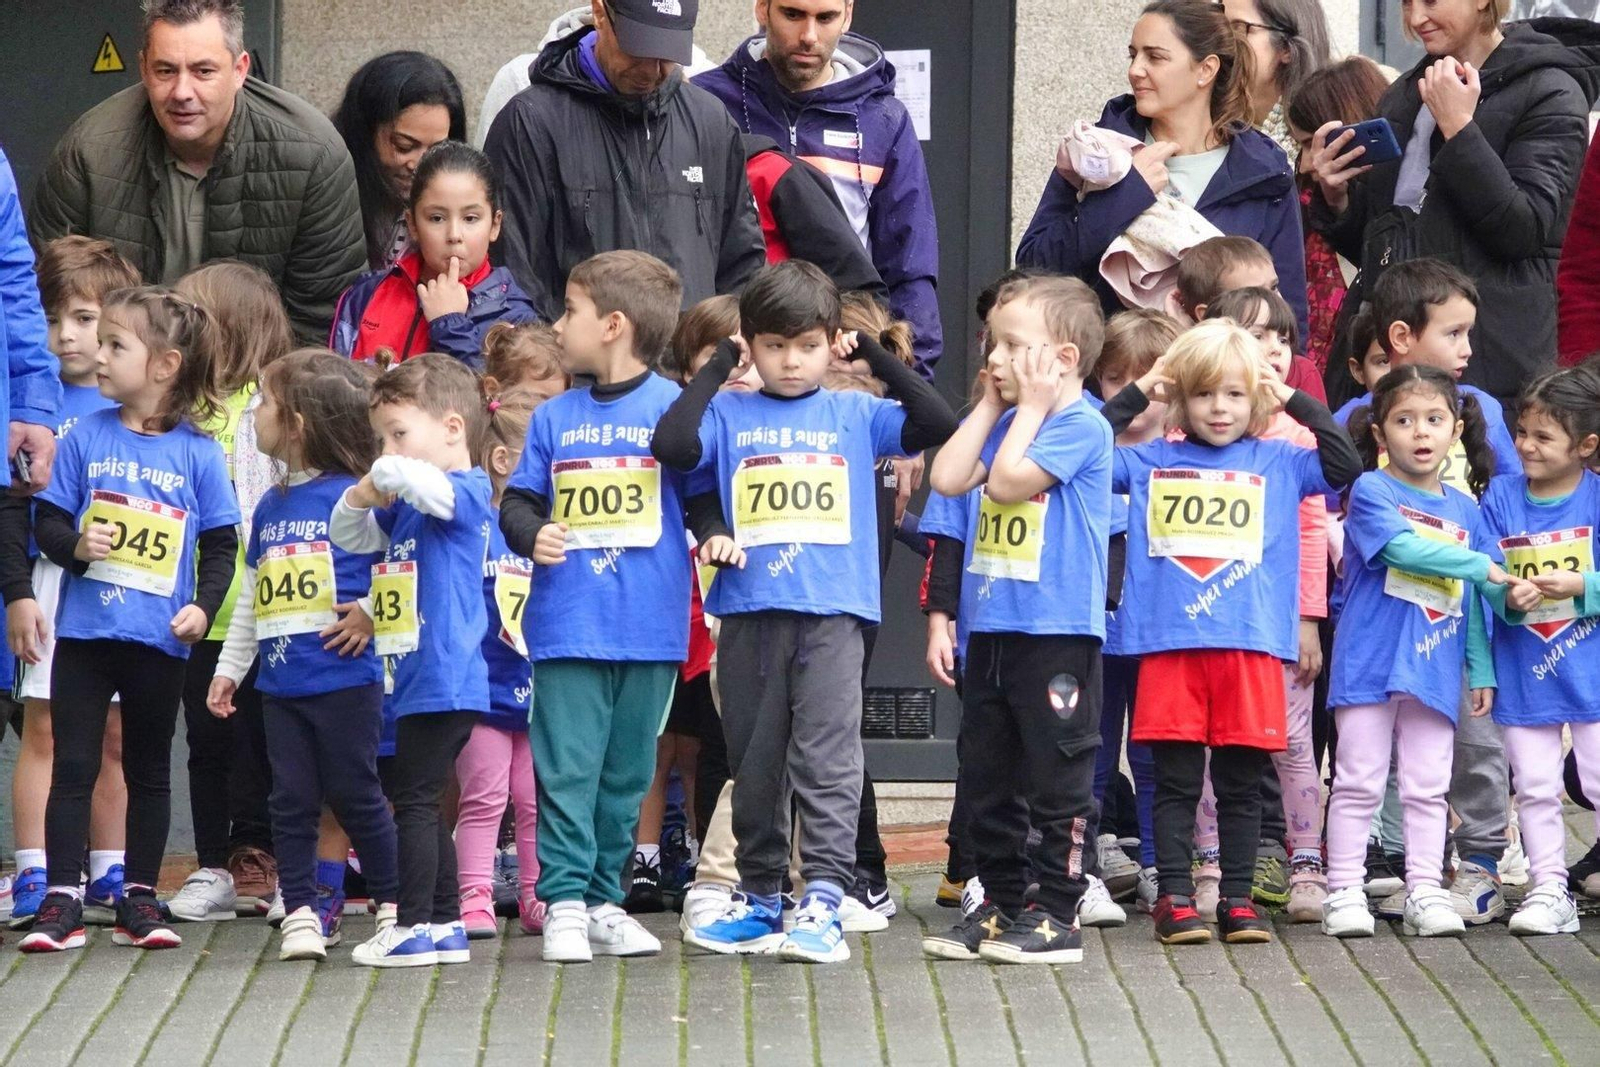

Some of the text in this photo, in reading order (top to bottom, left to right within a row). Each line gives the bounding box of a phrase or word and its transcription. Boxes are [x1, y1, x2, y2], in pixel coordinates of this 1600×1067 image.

[562, 423, 599, 447] máis
[737, 427, 778, 447] máis
[795, 430, 838, 451] auga
[88, 457, 125, 478] máis
[140, 465, 186, 492] auga
[559, 484, 644, 518] 7003
[747, 480, 834, 514] 7006
[1163, 495, 1250, 528] 7020
[288, 520, 327, 541] auga
[767, 543, 804, 577] super
[1185, 583, 1222, 620] super
[1532, 642, 1566, 680] super
